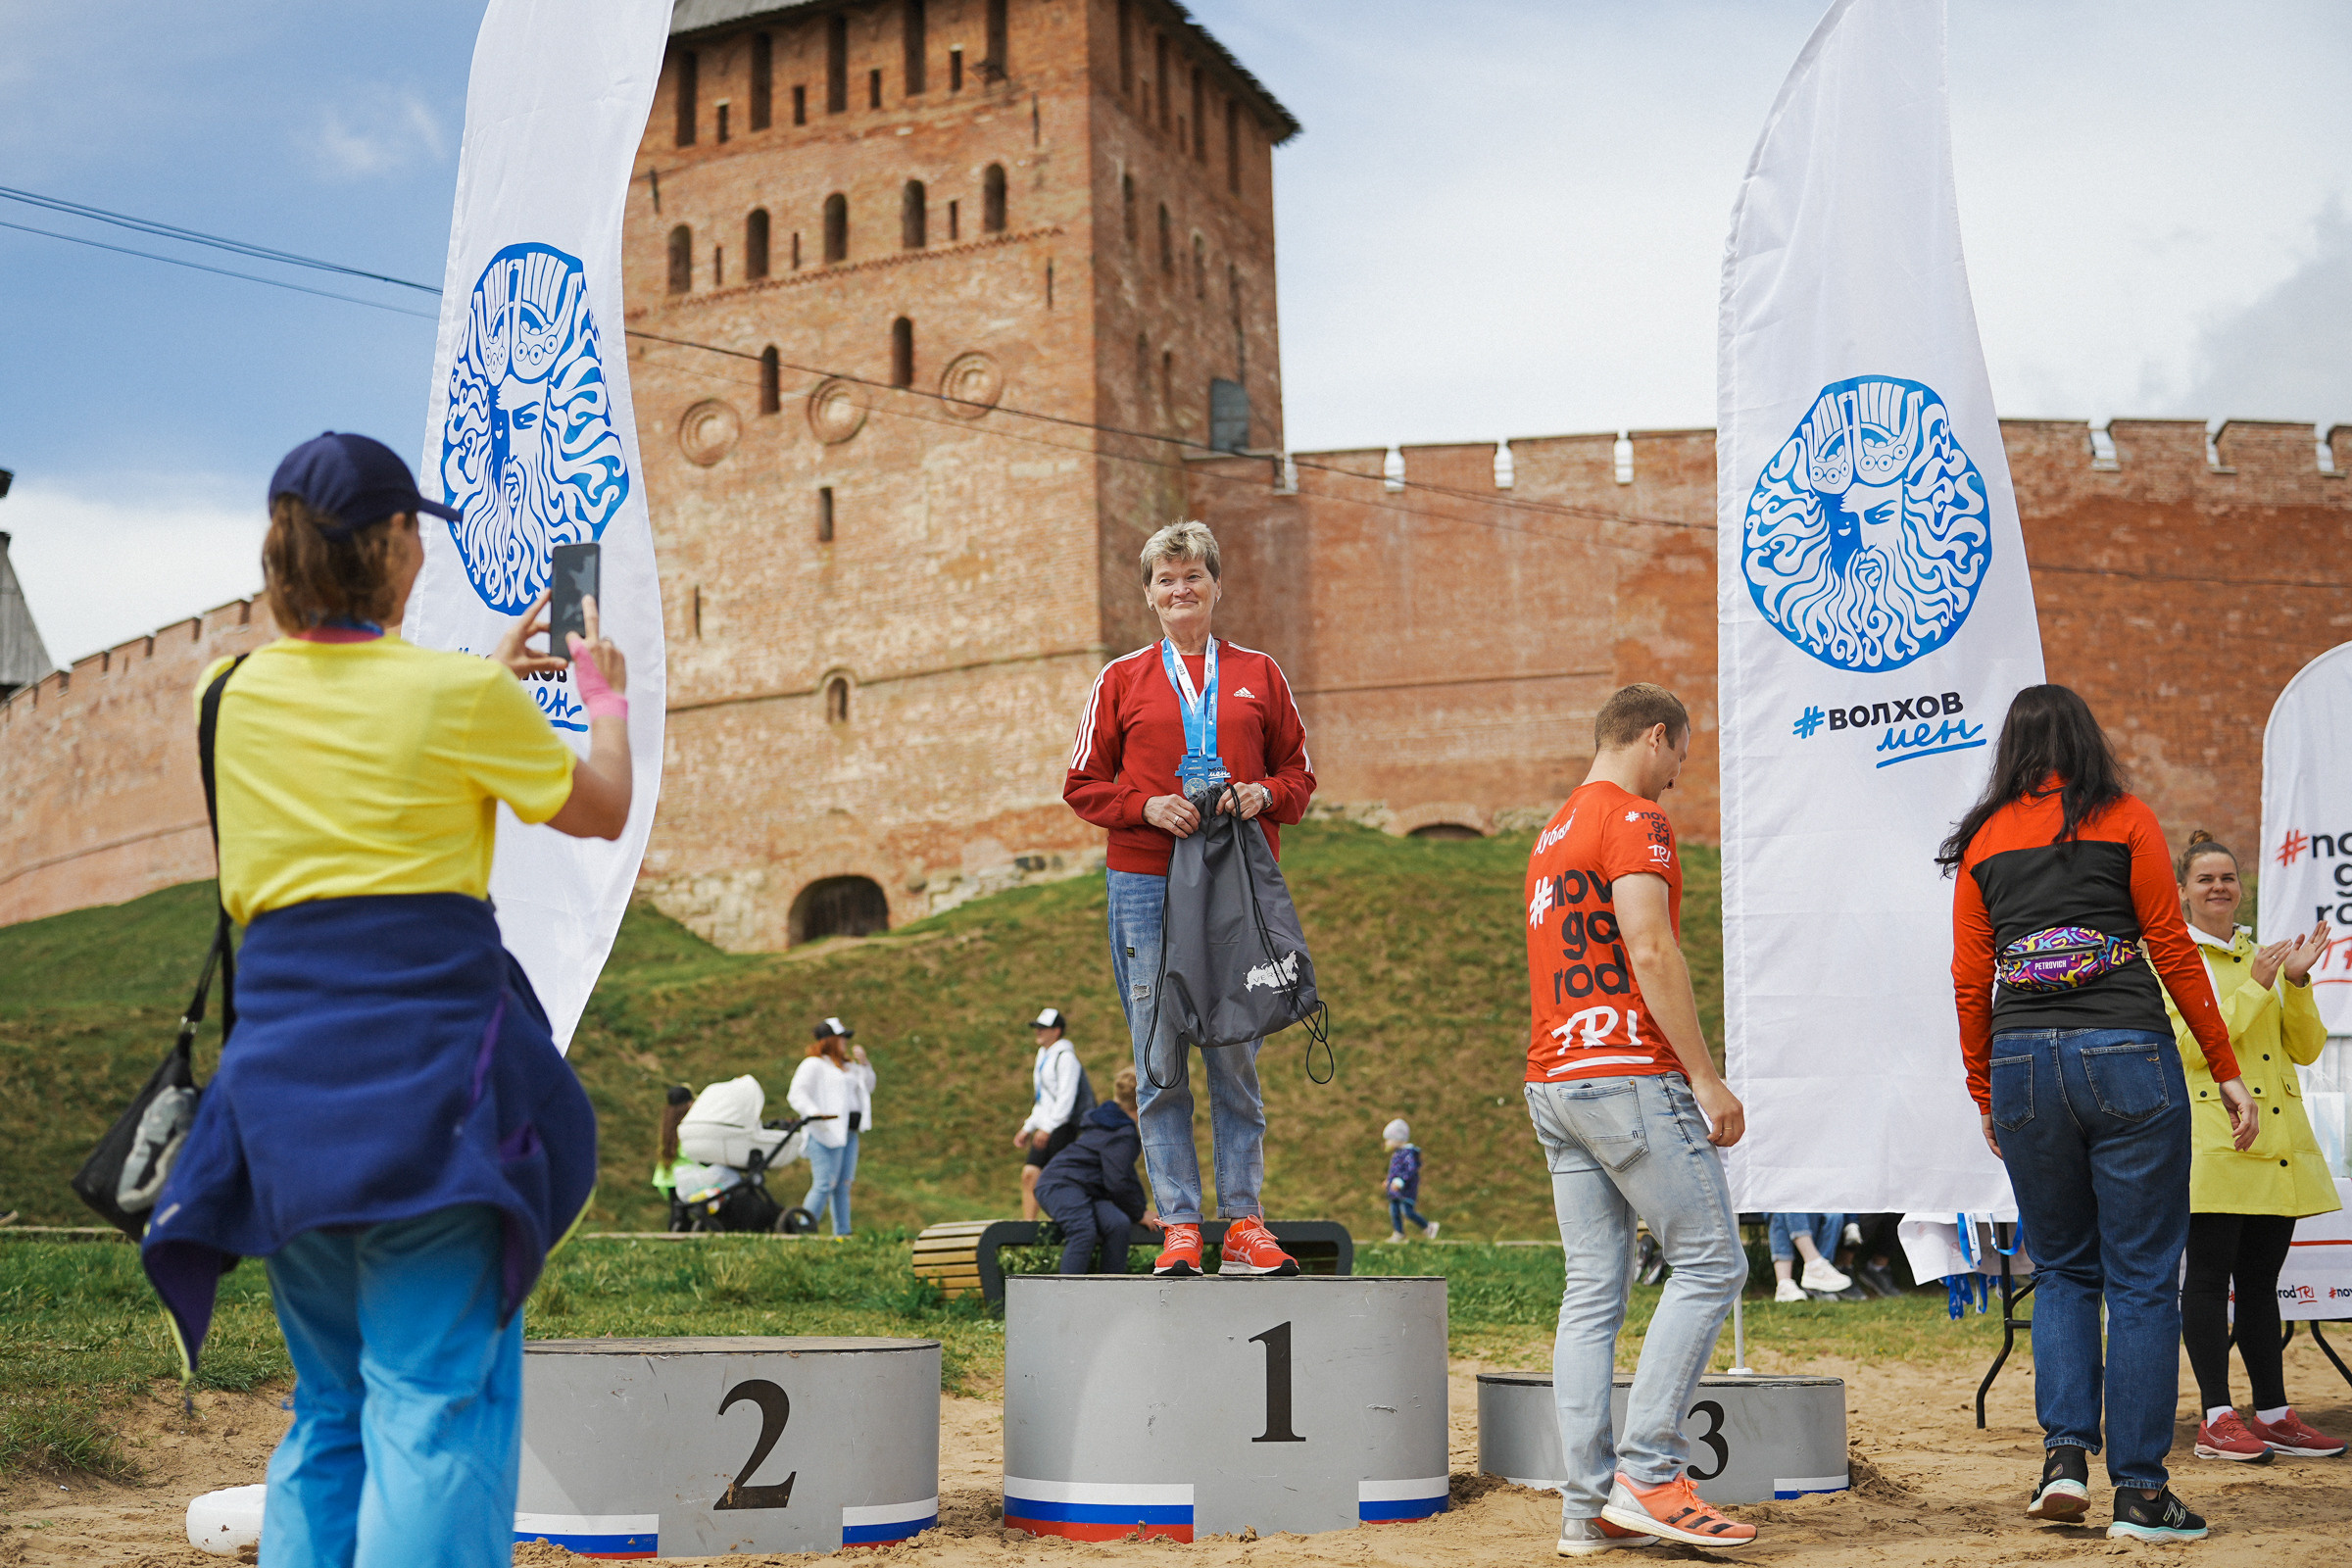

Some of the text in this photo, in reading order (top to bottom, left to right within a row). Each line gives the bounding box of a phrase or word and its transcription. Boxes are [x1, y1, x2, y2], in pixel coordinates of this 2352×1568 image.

[536, 686, 583, 718] ен
[1792, 692, 1964, 739] #ВОЛХОВ
[1876, 718, 1984, 752] мен
[1625, 810, 1667, 822] #nov
[1647, 833, 1670, 846] rod
[1529, 869, 1612, 929] #nov
[1561, 910, 1621, 960] go
[1553, 944, 1631, 1004] rod
[2034, 959, 2067, 970] PETROVICH
[1550, 1005, 1642, 1055] TRI
[1249, 1321, 1306, 1442] 1
[713, 1379, 797, 1510] 2
[1687, 1399, 1729, 1480] 3
